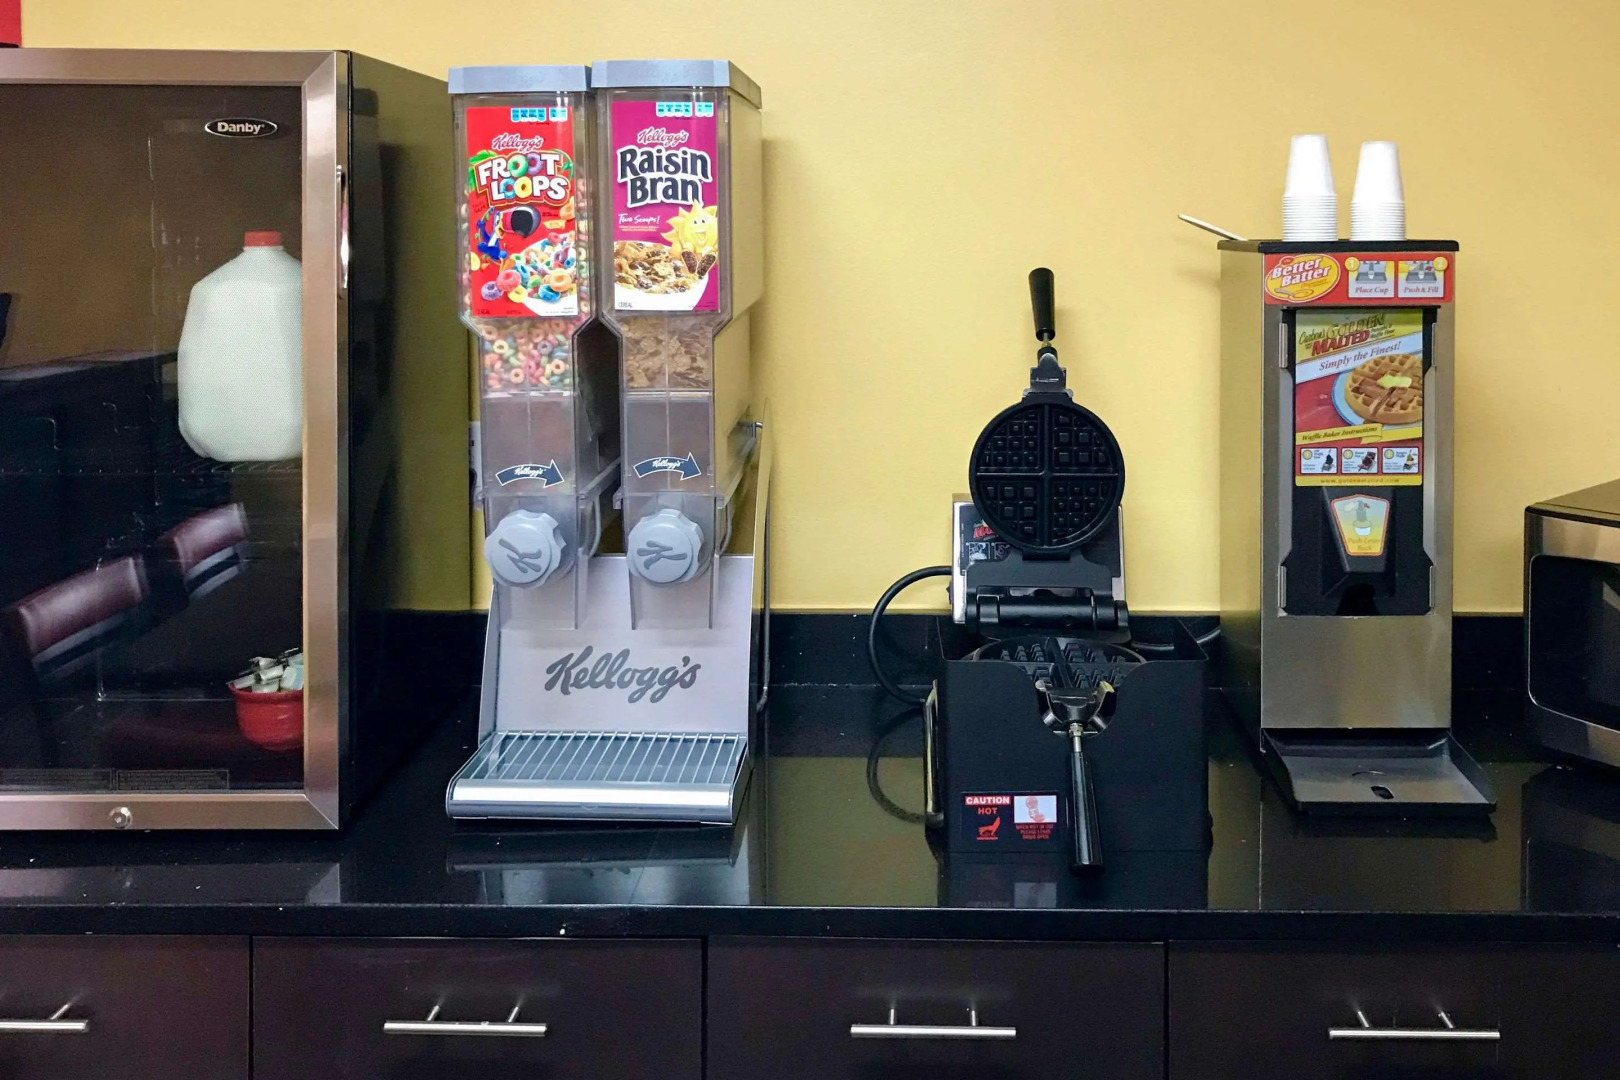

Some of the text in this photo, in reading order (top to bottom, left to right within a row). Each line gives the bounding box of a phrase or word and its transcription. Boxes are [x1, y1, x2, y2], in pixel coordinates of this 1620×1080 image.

[217, 122, 262, 135] Danby
[637, 127, 690, 147] Kellogg's
[491, 133, 545, 153] Kellogg's
[478, 153, 560, 187] FROOT
[618, 148, 711, 181] Raisin
[491, 175, 568, 201] LOOPS
[629, 176, 701, 205] Bran
[618, 213, 661, 225] Two Scoops!
[1271, 256, 1323, 279] Better
[1280, 265, 1331, 288] Batter
[1355, 286, 1389, 295] Place Cup
[1403, 286, 1421, 294] Push
[1427, 286, 1439, 294] Fill
[1311, 330, 1370, 356] MALTED
[1318, 341, 1402, 371] Simply the Finest!
[514, 465, 544, 476] Kellogg's
[652, 456, 682, 469] Kellogg's
[544, 645, 702, 704] Kellogg's
[965, 796, 1011, 805] CAUTION
[977, 807, 998, 815] HOT
